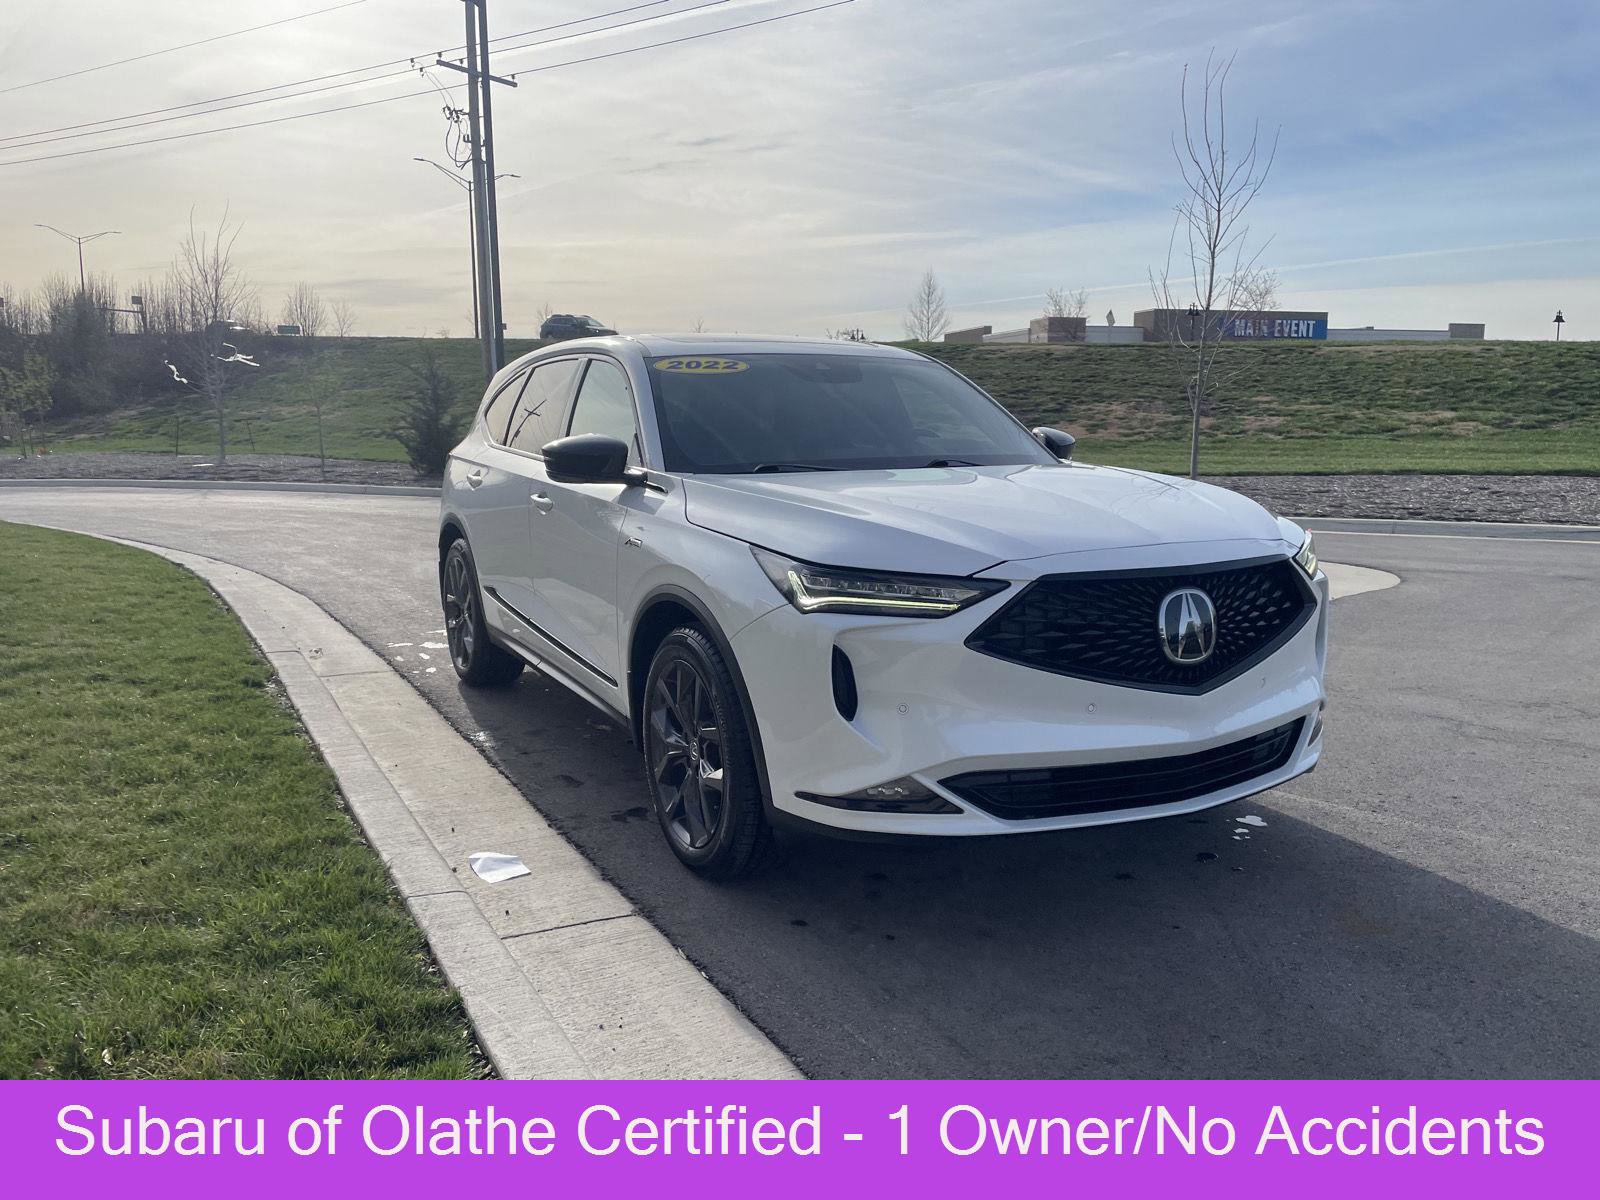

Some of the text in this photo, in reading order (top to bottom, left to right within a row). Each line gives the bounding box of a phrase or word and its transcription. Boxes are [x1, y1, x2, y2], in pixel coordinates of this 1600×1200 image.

[1234, 319, 1316, 338] MAIN EVENT
[665, 360, 739, 370] 2022
